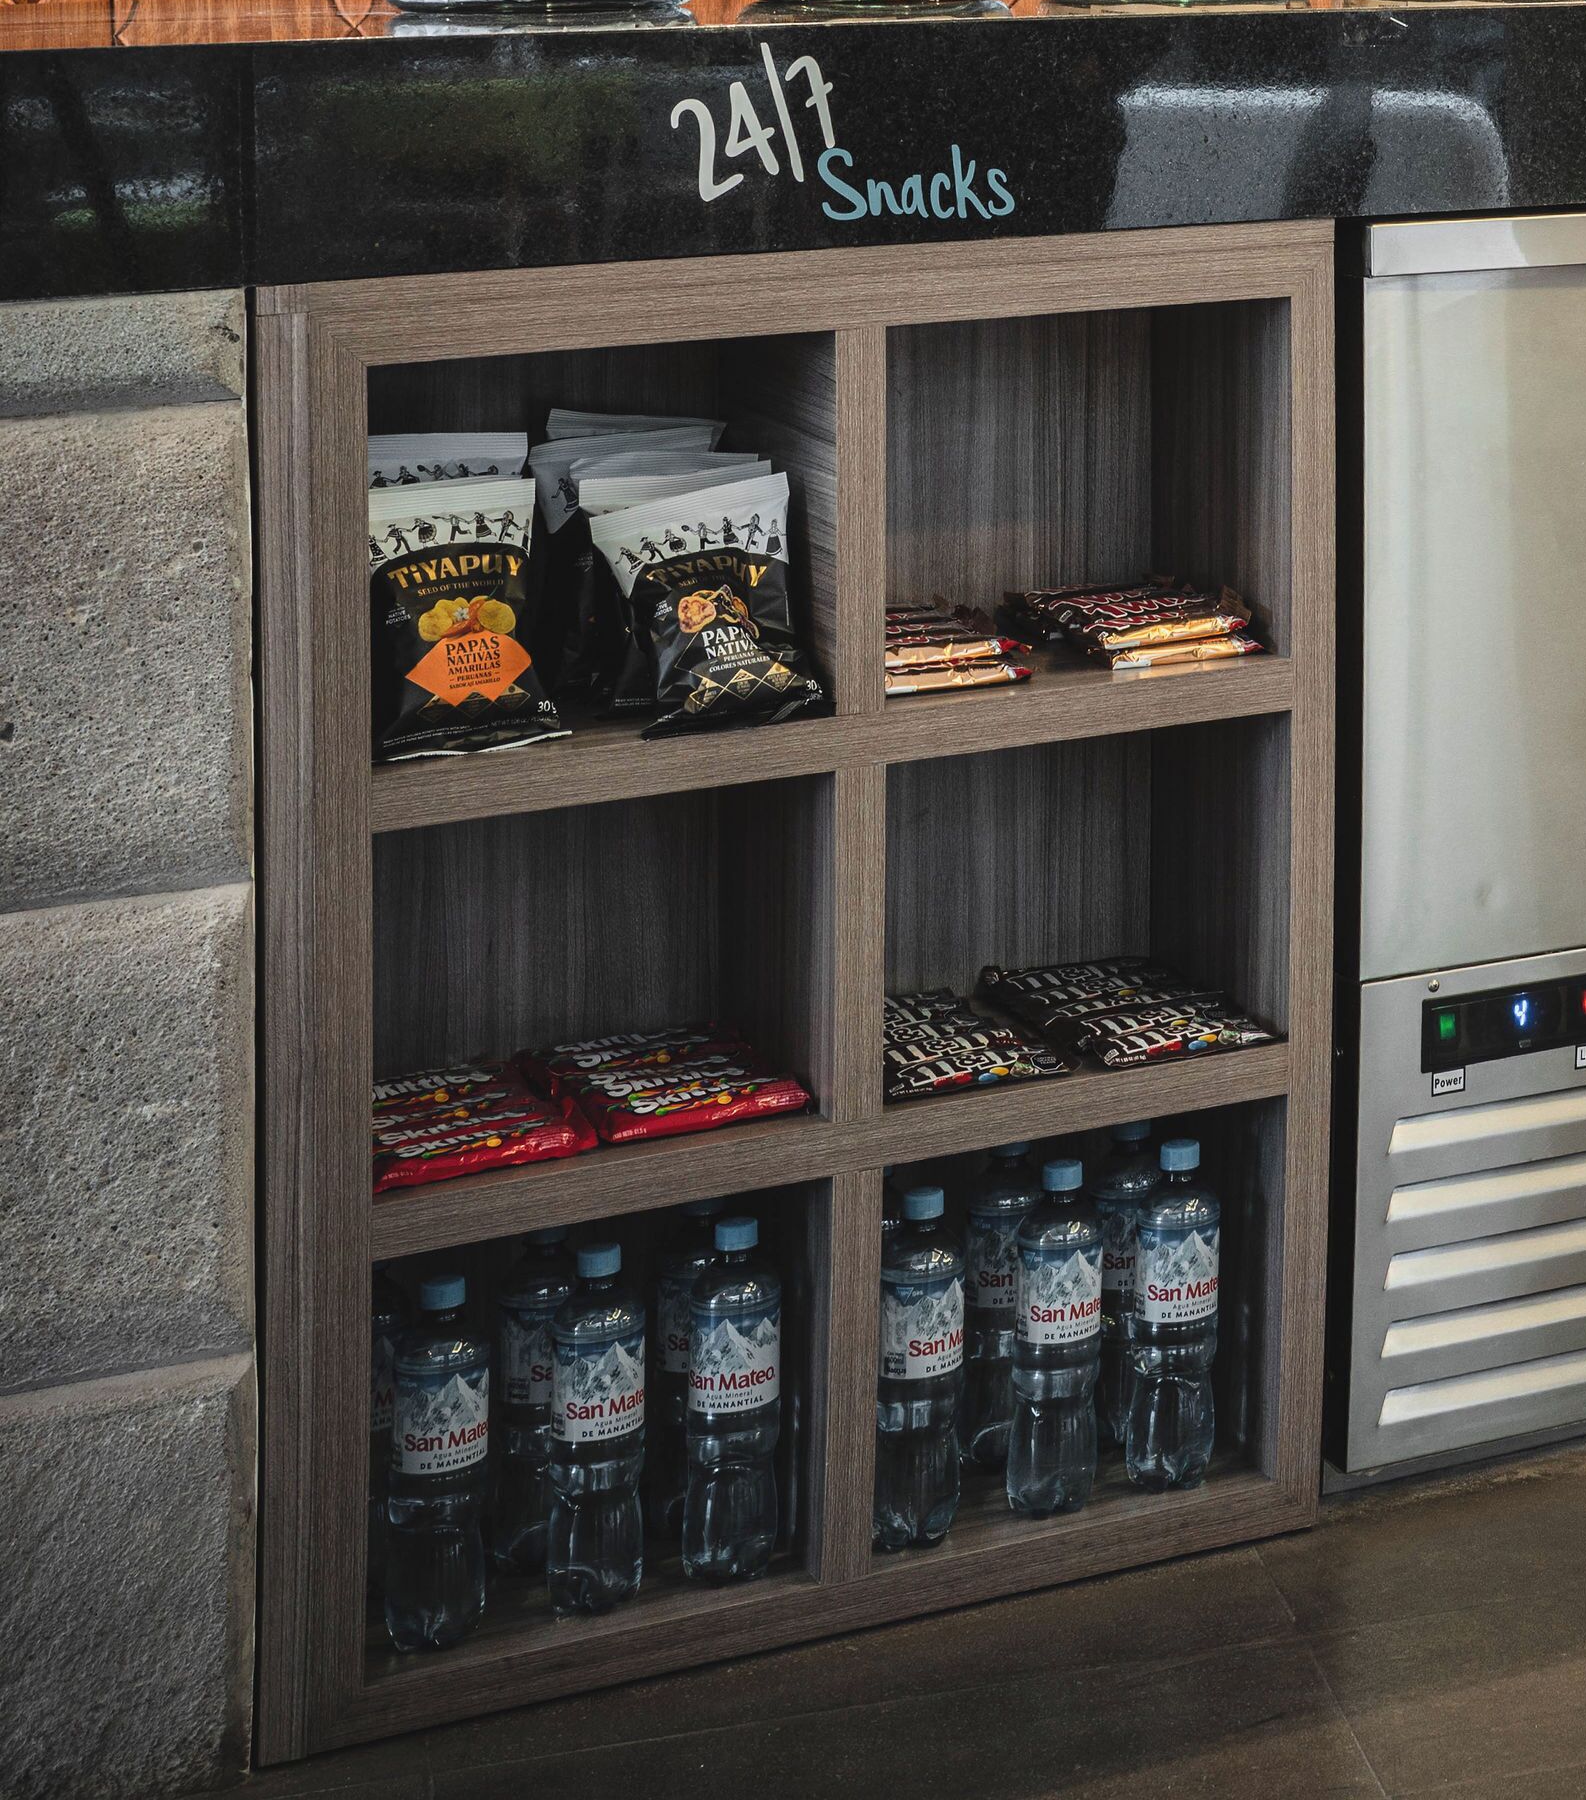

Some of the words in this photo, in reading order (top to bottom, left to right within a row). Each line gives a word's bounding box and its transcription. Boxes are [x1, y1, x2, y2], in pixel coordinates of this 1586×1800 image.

[671, 42, 836, 202] 24/7
[817, 143, 1016, 221] Snacks
[417, 585, 439, 597] SEED
[445, 636, 501, 657] PAPAS
[447, 650, 501, 667] NATIVAS
[448, 660, 501, 676] AMARILLAS
[456, 671, 493, 682] PERUANAS
[1434, 1076, 1463, 1089] Power
[979, 1271, 1013, 1288] San
[1147, 1284, 1182, 1302] San
[1030, 1304, 1065, 1323] San
[1161, 1311, 1172, 1319] DE
[1044, 1332, 1055, 1340] DE
[908, 1338, 946, 1358] San
[690, 1369, 715, 1391] San
[718, 1366, 775, 1392] Mateo
[697, 1401, 706, 1409] DE
[709, 1395, 764, 1409] MANANTIAL
[566, 1402, 604, 1420] San
[582, 1430, 594, 1438] DE
[405, 1434, 443, 1453] San
[420, 1462, 432, 1470] DE
